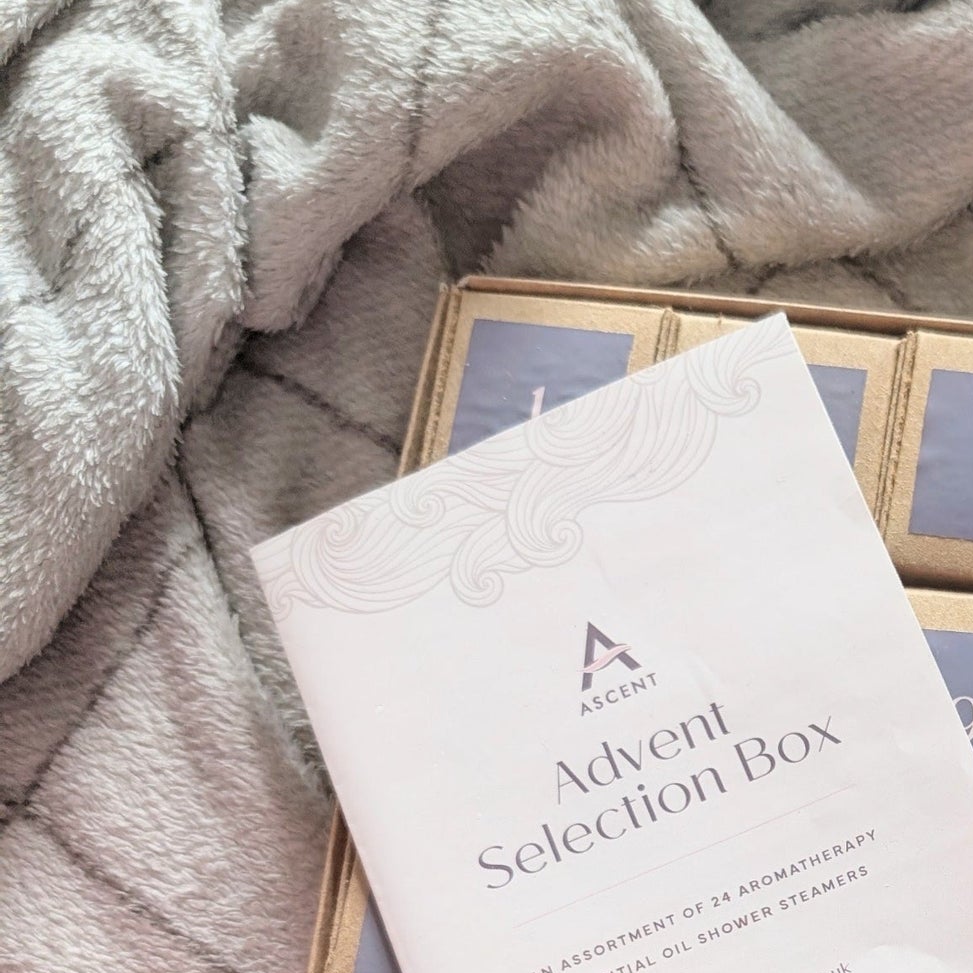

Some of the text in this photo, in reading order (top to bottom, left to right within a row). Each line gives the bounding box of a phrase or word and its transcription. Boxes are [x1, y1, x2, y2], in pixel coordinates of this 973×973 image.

[580, 672, 658, 717] ASCENT
[478, 716, 842, 888] Selection Box
[556, 702, 731, 805] Advent
[561, 914, 676, 971] ASSORTMENT
[683, 902, 705, 919] OF
[711, 892, 732, 908] 24
[739, 829, 876, 897] AROMATHERAPY
[662, 941, 691, 959] OIL
[697, 907, 773, 945] SHOWER
[779, 865, 869, 910] STEAMERS
